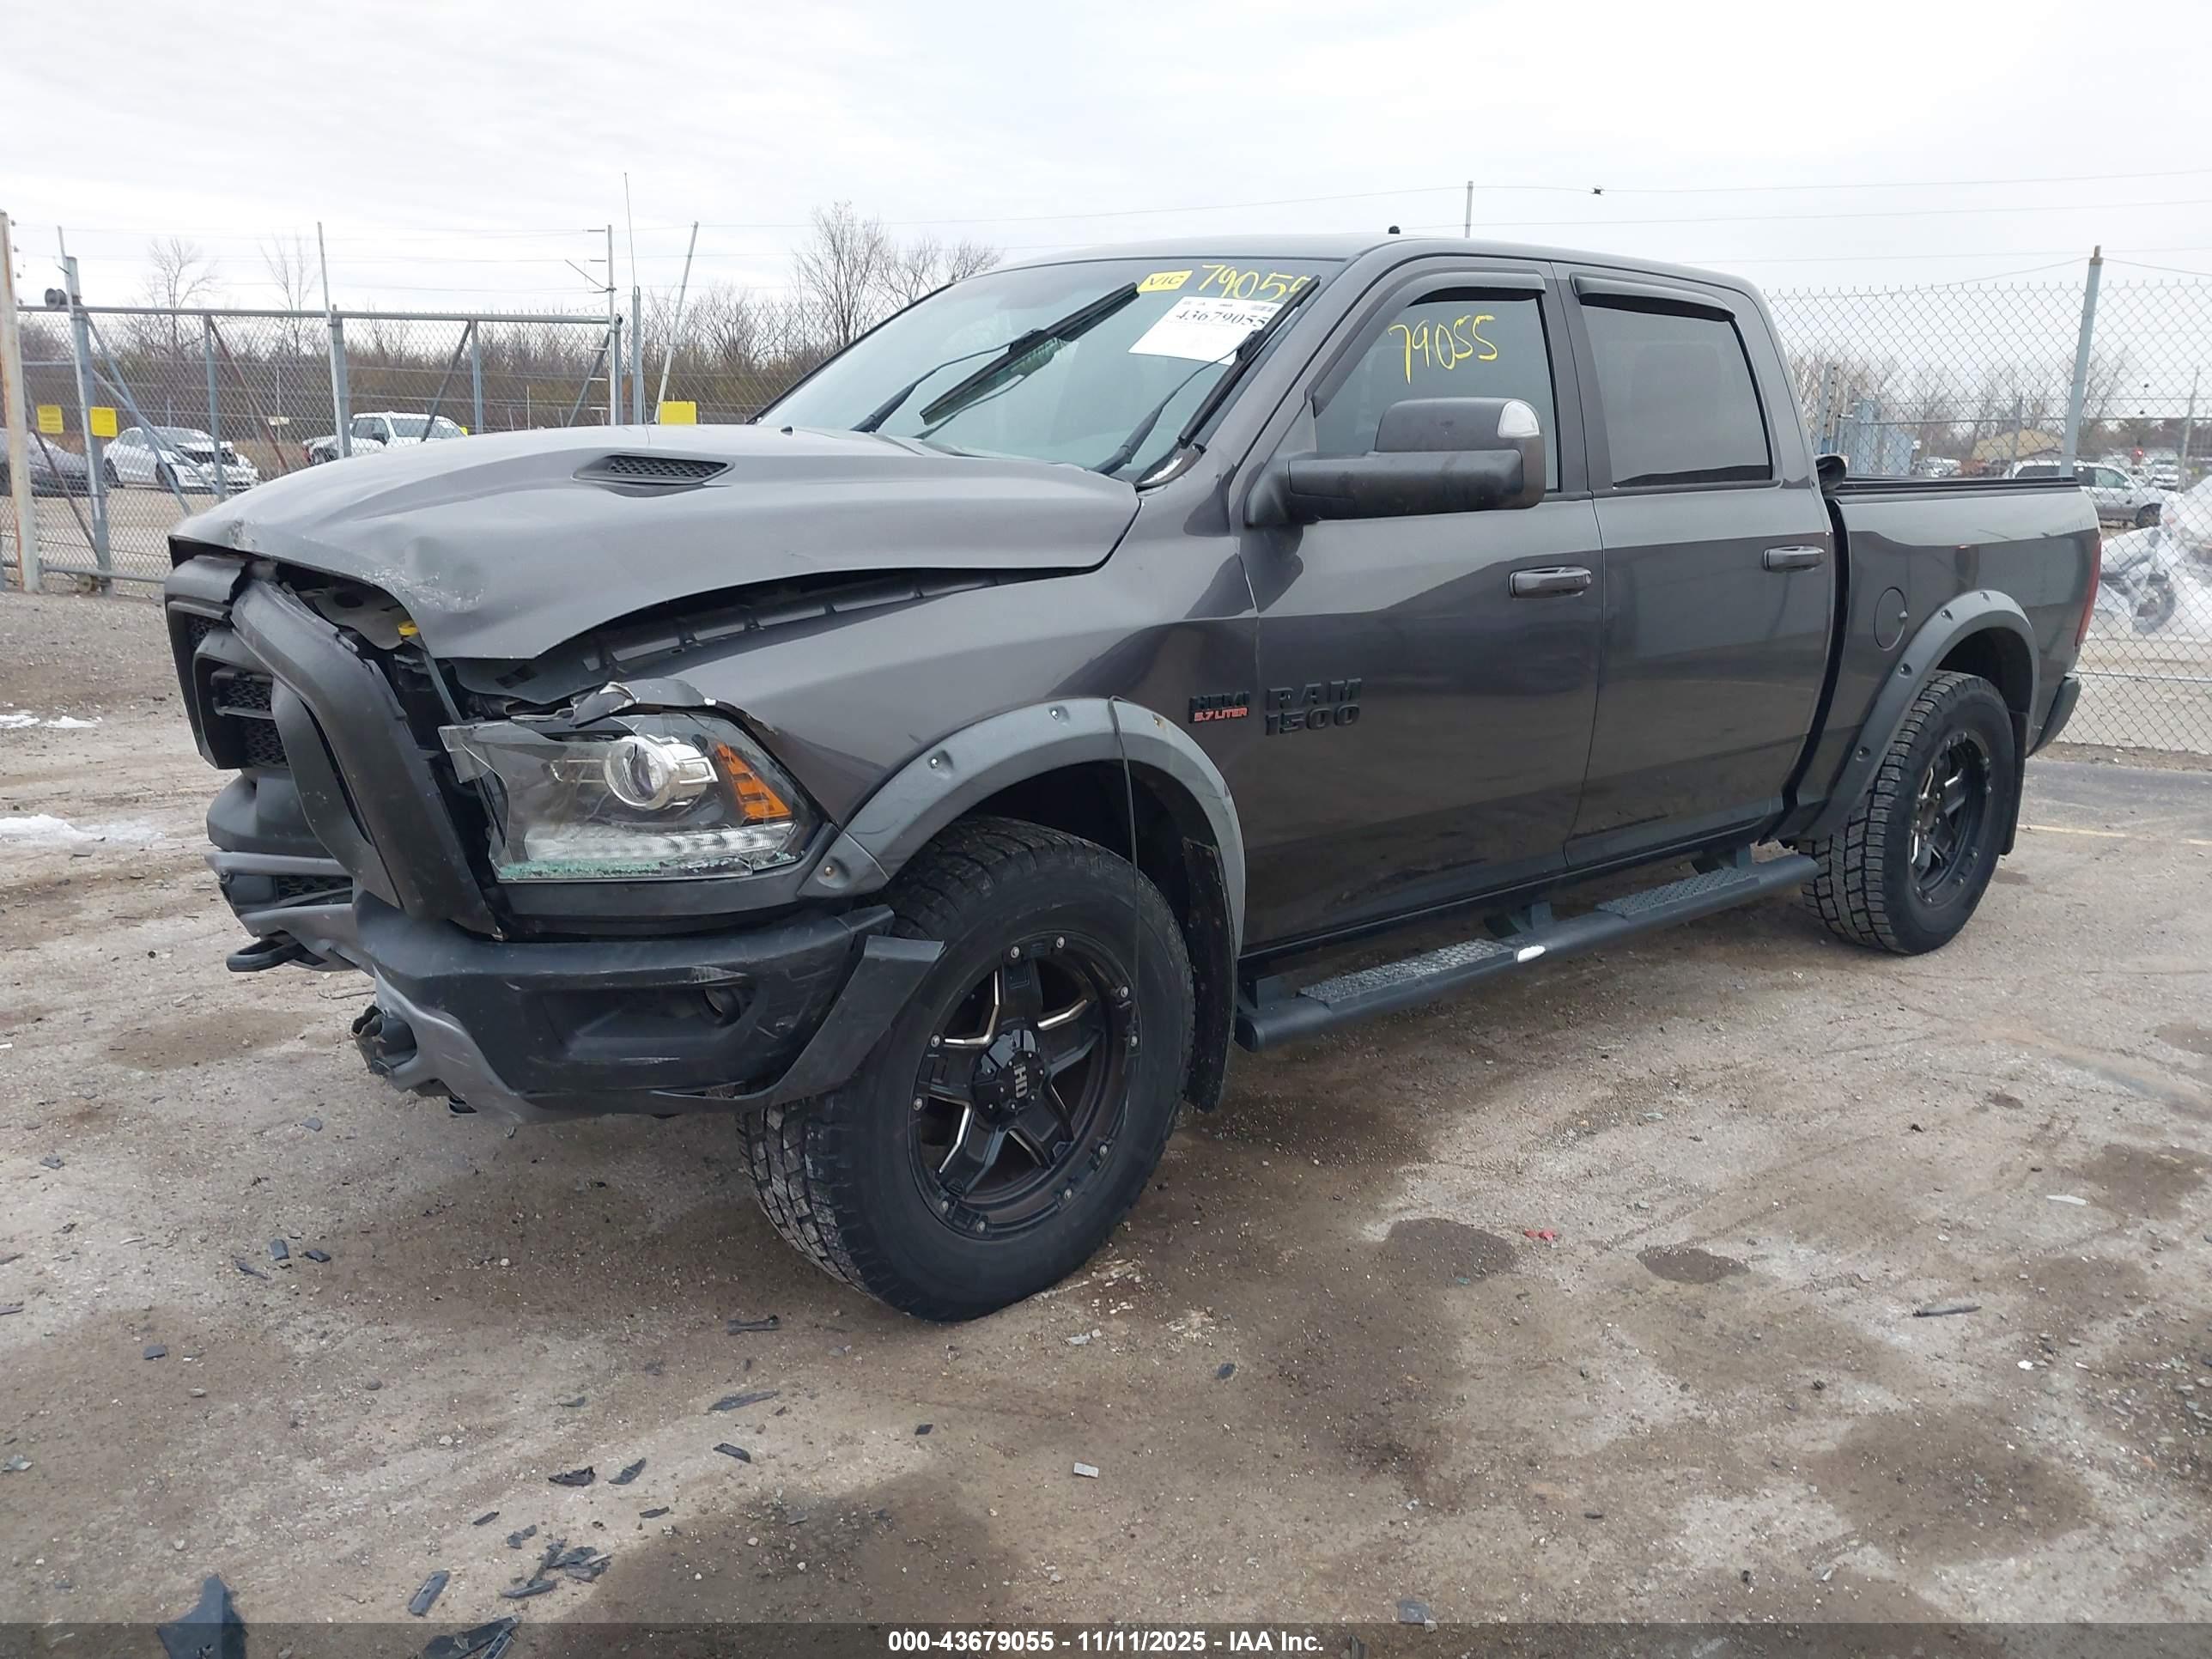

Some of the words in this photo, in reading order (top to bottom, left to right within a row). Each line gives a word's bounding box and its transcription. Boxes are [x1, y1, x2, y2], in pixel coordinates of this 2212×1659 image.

[1149, 275, 1185, 286] VIC
[1388, 314, 1498, 385] 79055
[1266, 678, 1362, 712] RAM
[1194, 710, 1213, 722] 5.7
[1215, 707, 1248, 720] LITER
[1265, 704, 1361, 736] 1500
